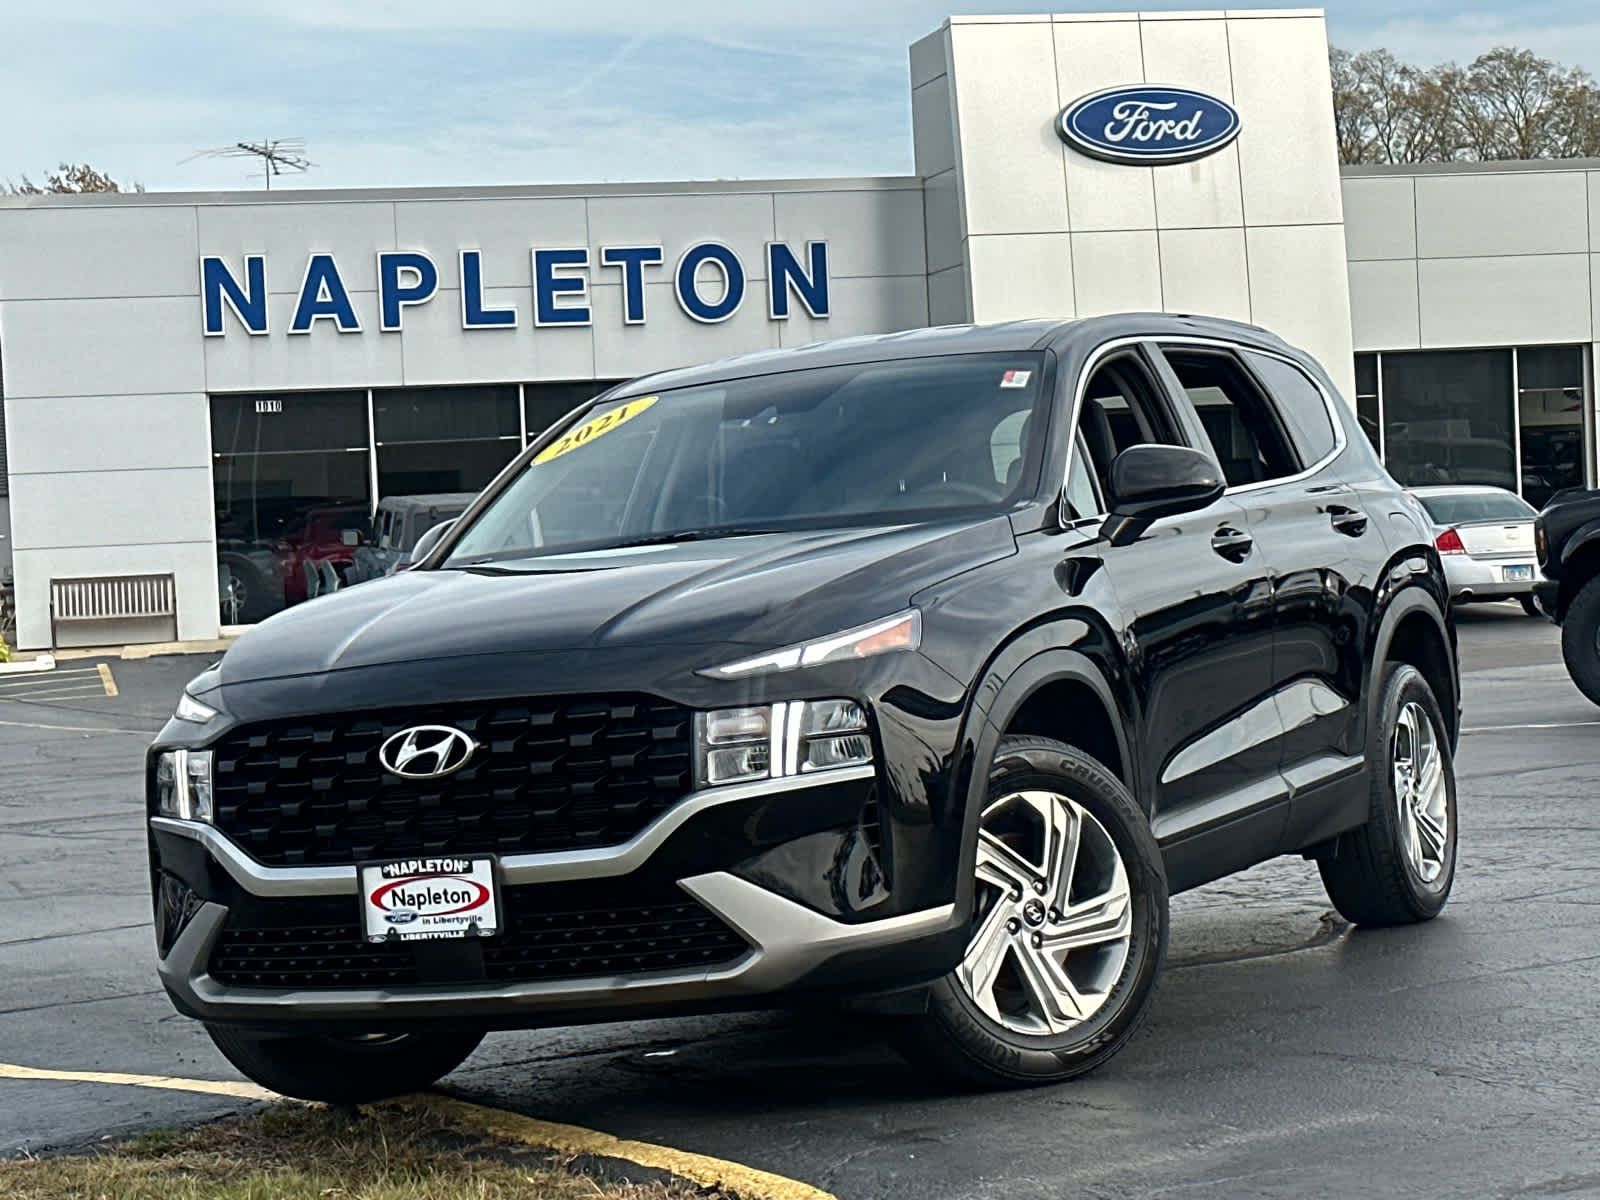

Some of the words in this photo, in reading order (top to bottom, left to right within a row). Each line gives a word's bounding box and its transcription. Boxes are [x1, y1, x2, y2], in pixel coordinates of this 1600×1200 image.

[1104, 101, 1203, 141] Ford
[201, 241, 830, 336] NAPLETON
[555, 408, 627, 455] 2021
[389, 859, 463, 877] NAPLETON
[391, 887, 471, 909] Napleton
[422, 917, 430, 925] in
[433, 914, 483, 925] Libertyville
